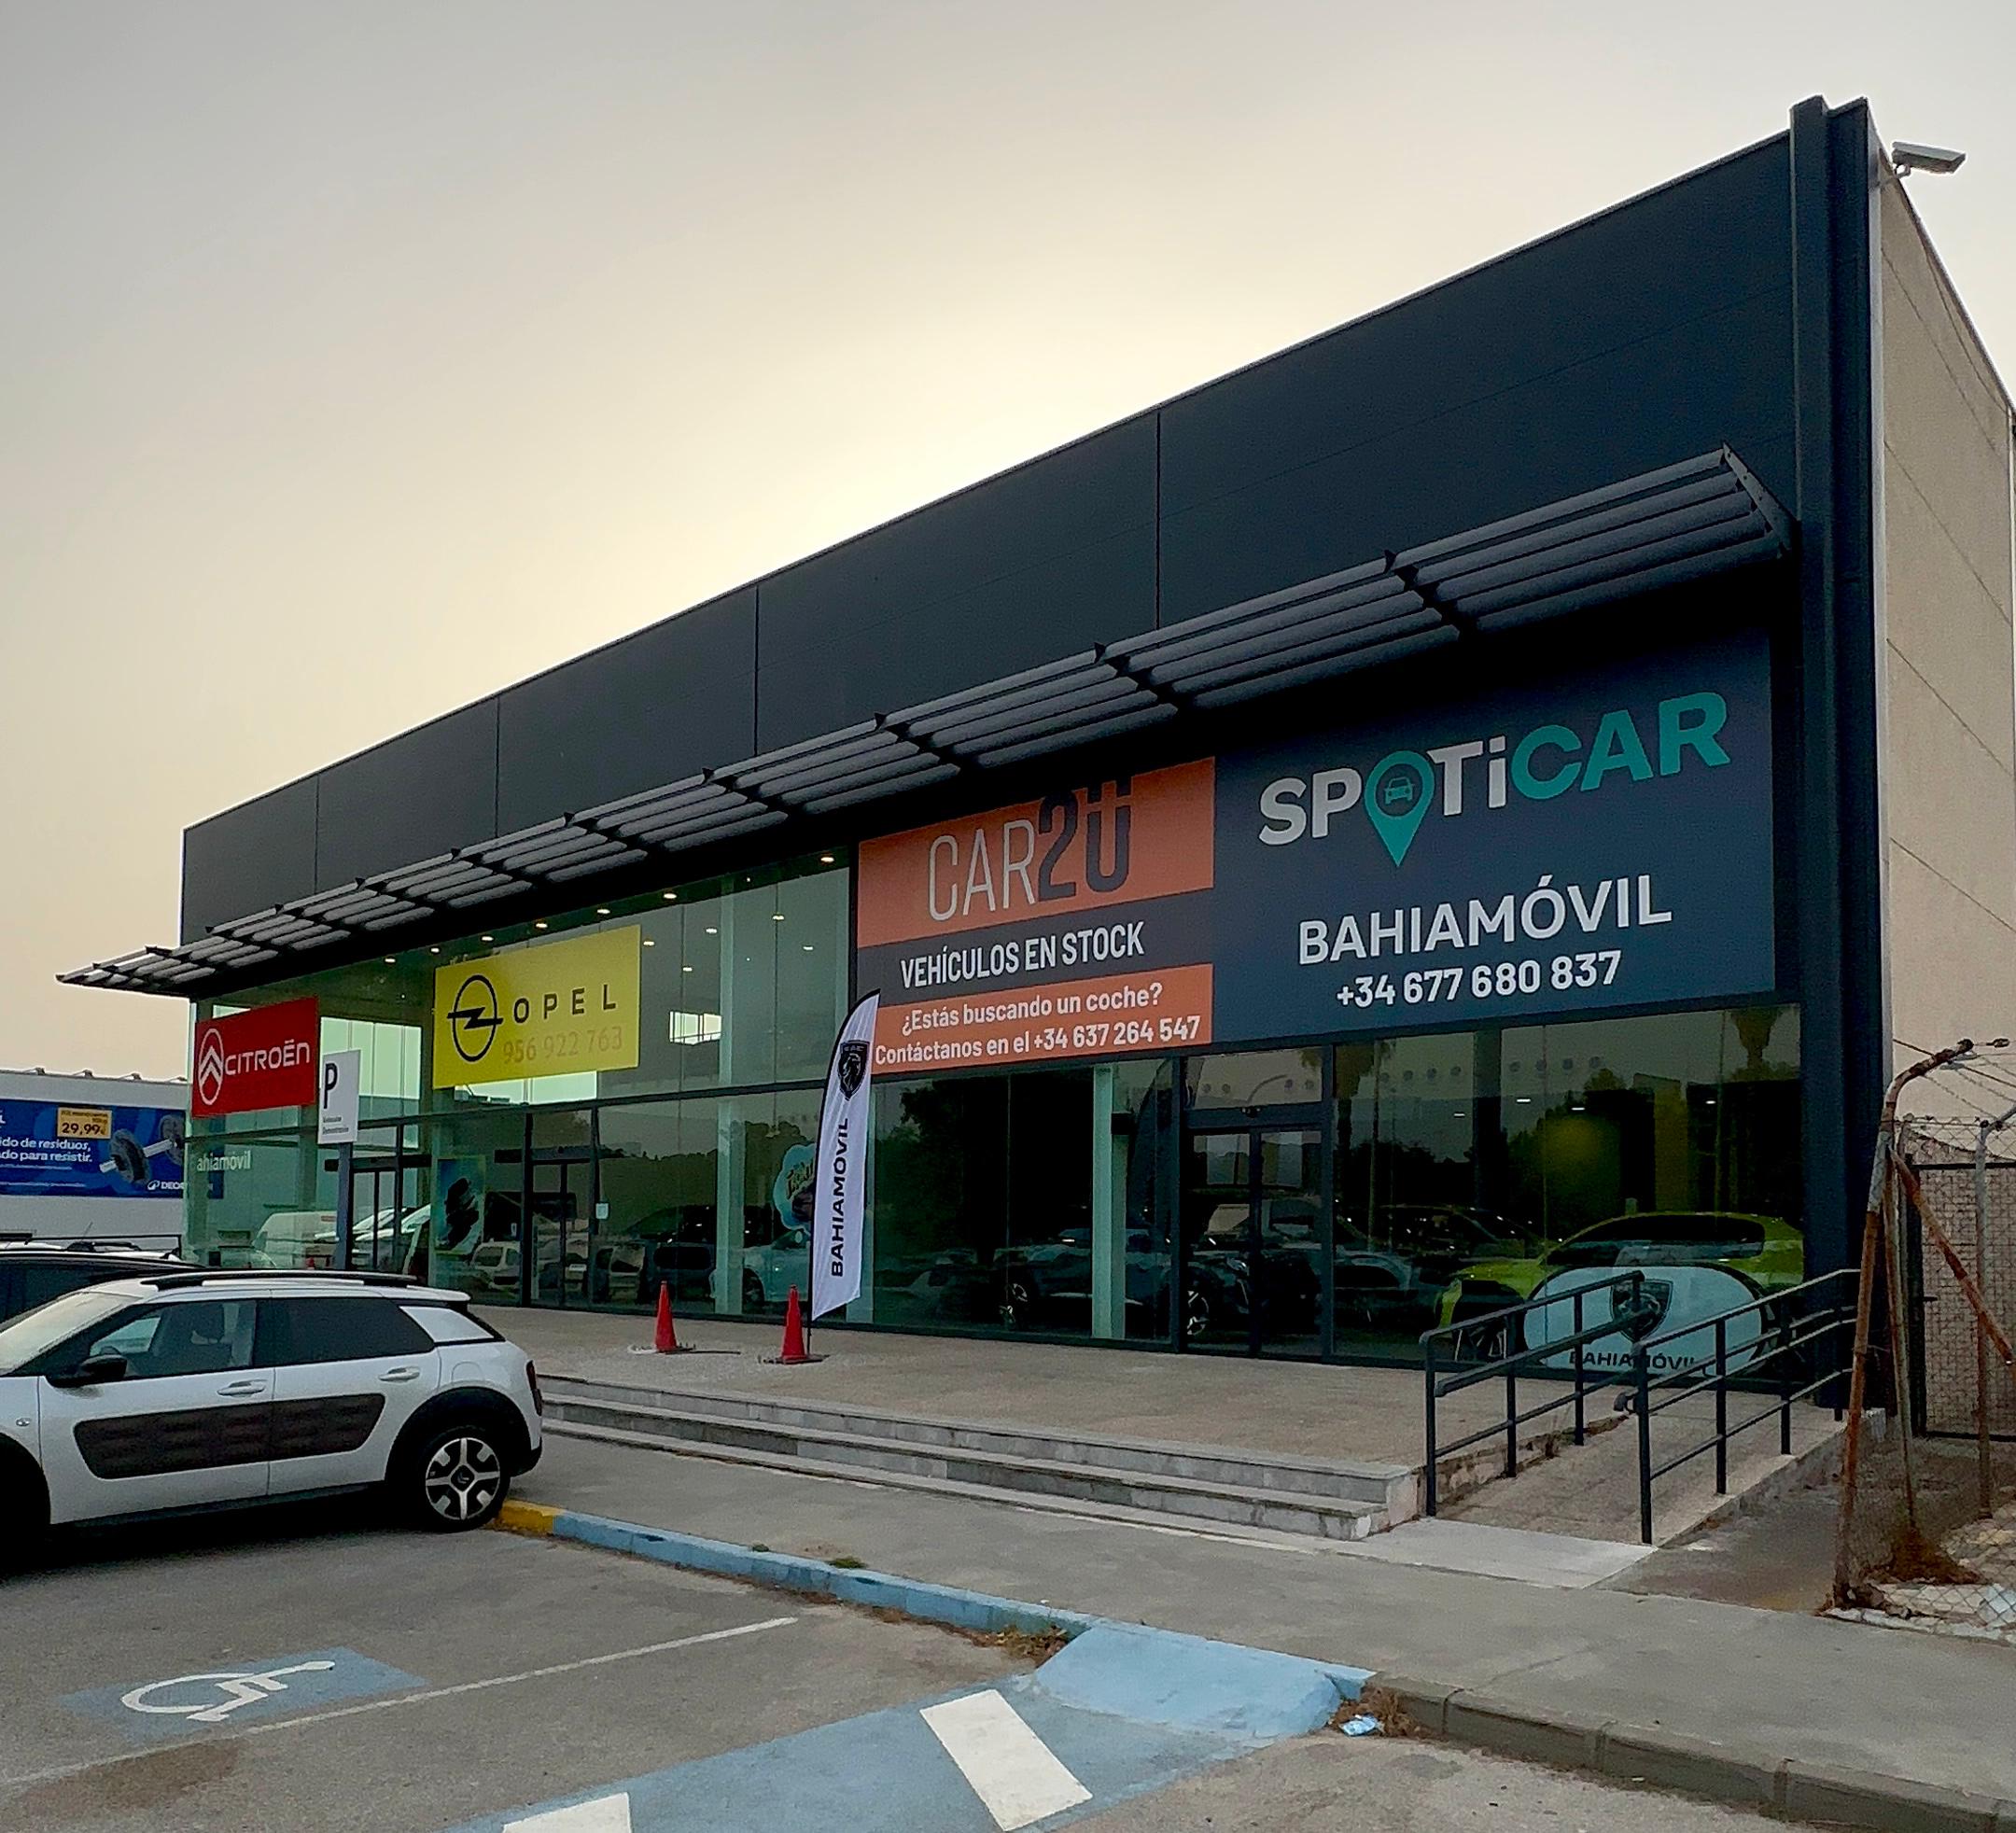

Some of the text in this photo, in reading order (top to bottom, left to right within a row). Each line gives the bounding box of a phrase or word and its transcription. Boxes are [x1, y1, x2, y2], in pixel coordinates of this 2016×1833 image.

[929, 778, 1130, 922] CAR2U
[1298, 875, 1673, 965] BAHIAMÓVIL
[900, 921, 1145, 988] VEHÍCULOS EN STOCK
[1337, 949, 1622, 1008] +34 677 680 837
[513, 984, 616, 1024] OPEL
[902, 982, 1163, 1036] ¿Estás buscando un coche?
[503, 1027, 623, 1064] 956 922 763
[875, 1015, 1200, 1065] Contáctanos en el +34 637 264 547
[323, 1062, 338, 1110] P
[20, 1137, 36, 1148] de
[38, 1139, 91, 1152] residuos,
[20, 1152, 48, 1162] para
[1569, 1351, 1695, 1369] AHIAÓVI
